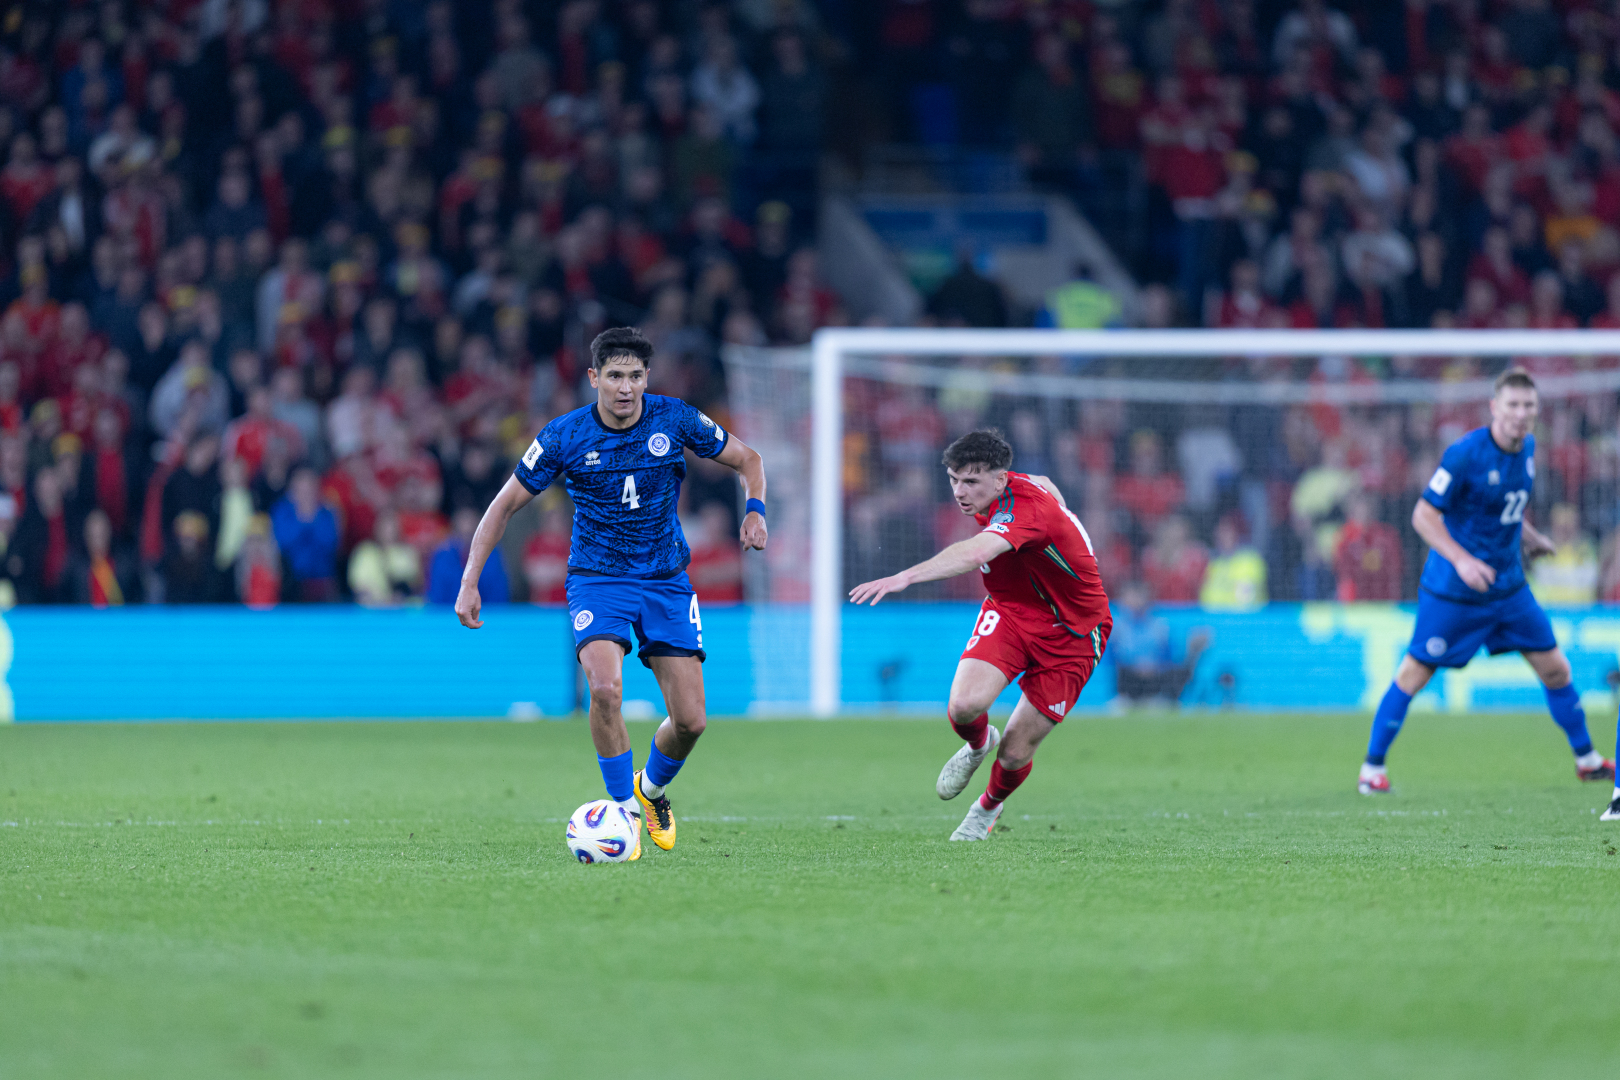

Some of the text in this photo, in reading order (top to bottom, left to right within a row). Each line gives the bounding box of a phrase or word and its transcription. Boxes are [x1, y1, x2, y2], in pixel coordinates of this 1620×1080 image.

[621, 475, 640, 510] 4
[1500, 490, 1528, 525] 22
[689, 593, 702, 631] 4
